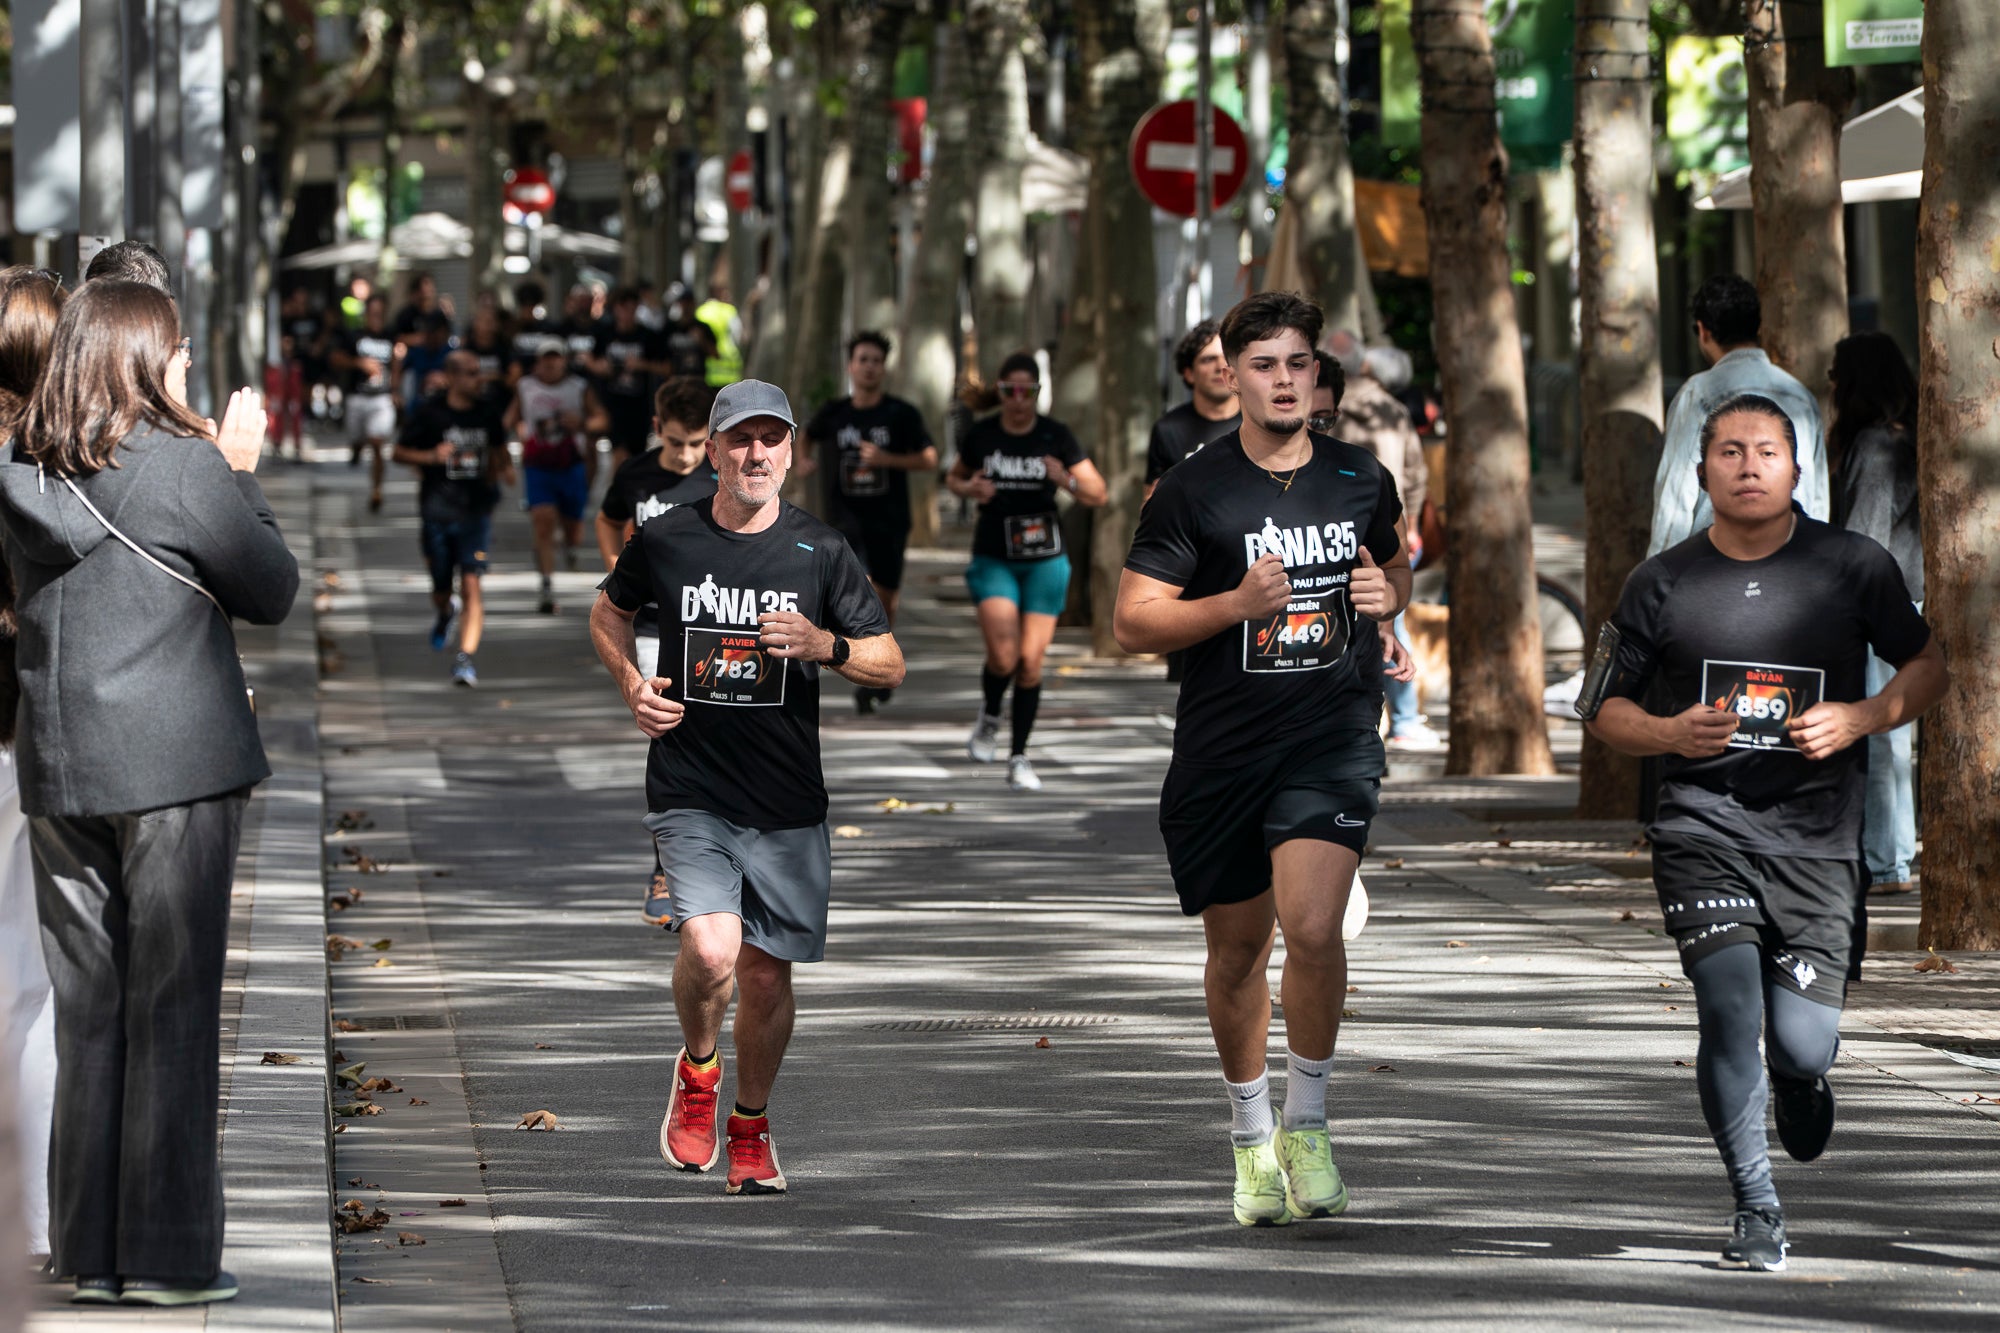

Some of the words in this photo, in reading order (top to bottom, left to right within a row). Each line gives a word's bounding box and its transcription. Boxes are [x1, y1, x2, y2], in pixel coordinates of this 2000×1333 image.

[1868, 32, 1920, 44] Terrassa
[1293, 577, 1314, 589] PAU
[1286, 600, 1320, 613] RUBÉN
[1277, 623, 1325, 645] 449
[721, 637, 756, 648] XAVIER
[714, 659, 758, 680] 782
[1745, 671, 1784, 684] BRYAN
[1736, 695, 1787, 721] 859
